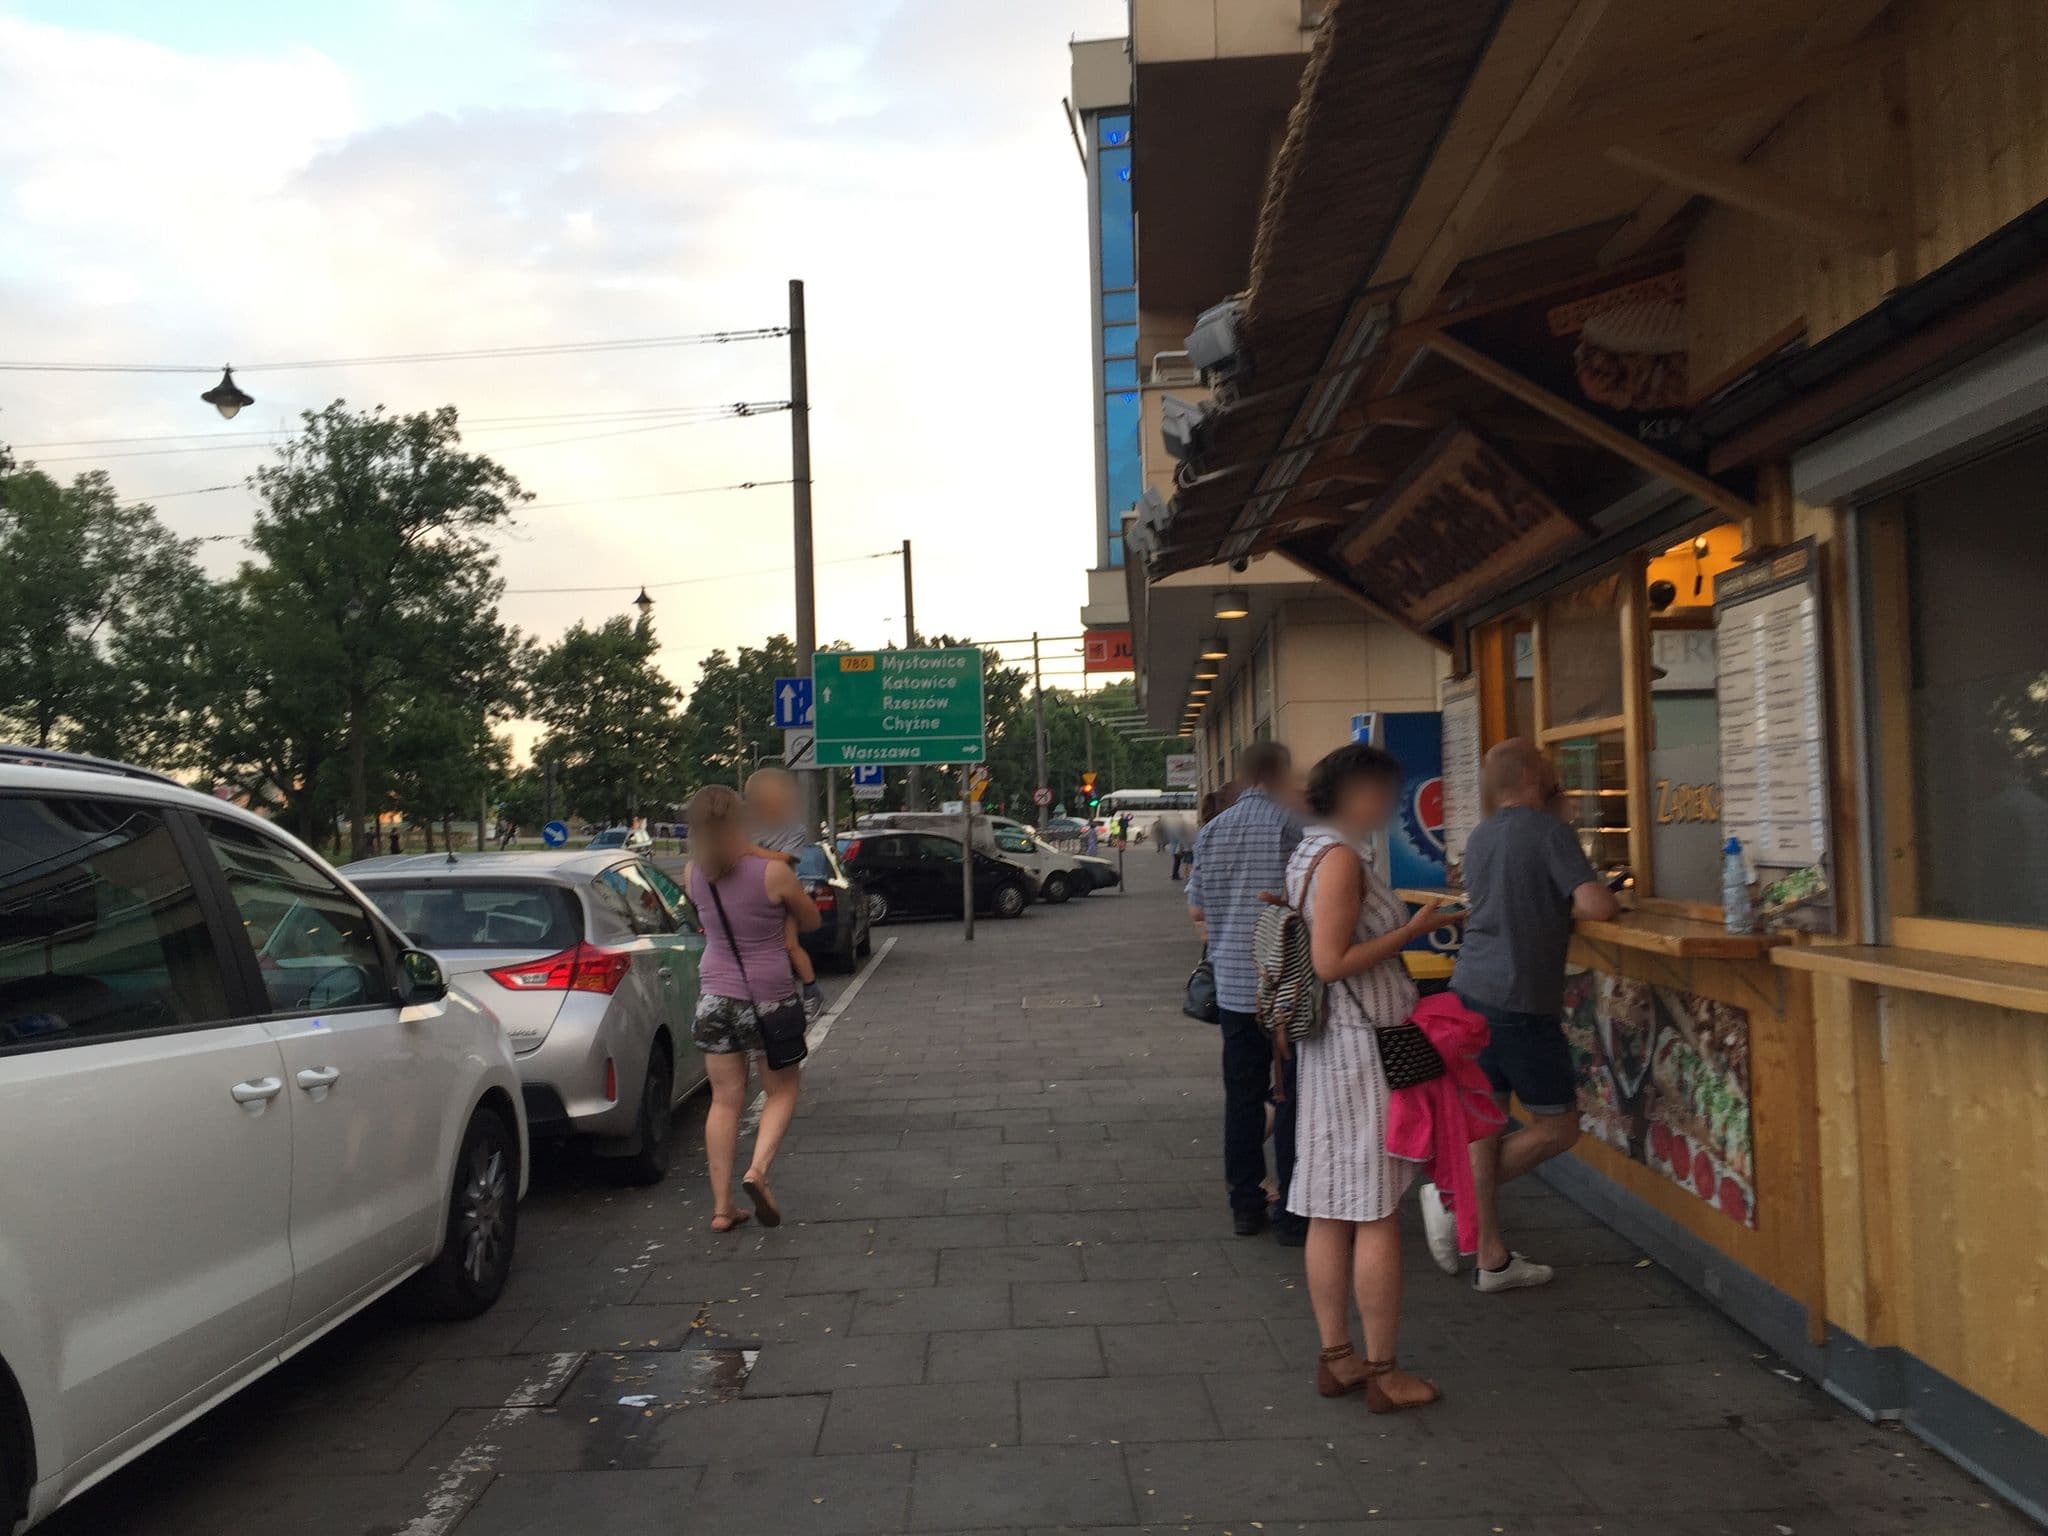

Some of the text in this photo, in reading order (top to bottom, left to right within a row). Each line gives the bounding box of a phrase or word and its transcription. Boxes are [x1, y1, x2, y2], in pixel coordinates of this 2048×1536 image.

[882, 655, 965, 672] Mysłowice
[882, 675, 957, 690] Katowice
[883, 695, 949, 710] Rzeszów
[882, 715, 940, 733] Chyżne
[842, 746, 920, 759] Warszawa
[860, 765, 877, 783] P
